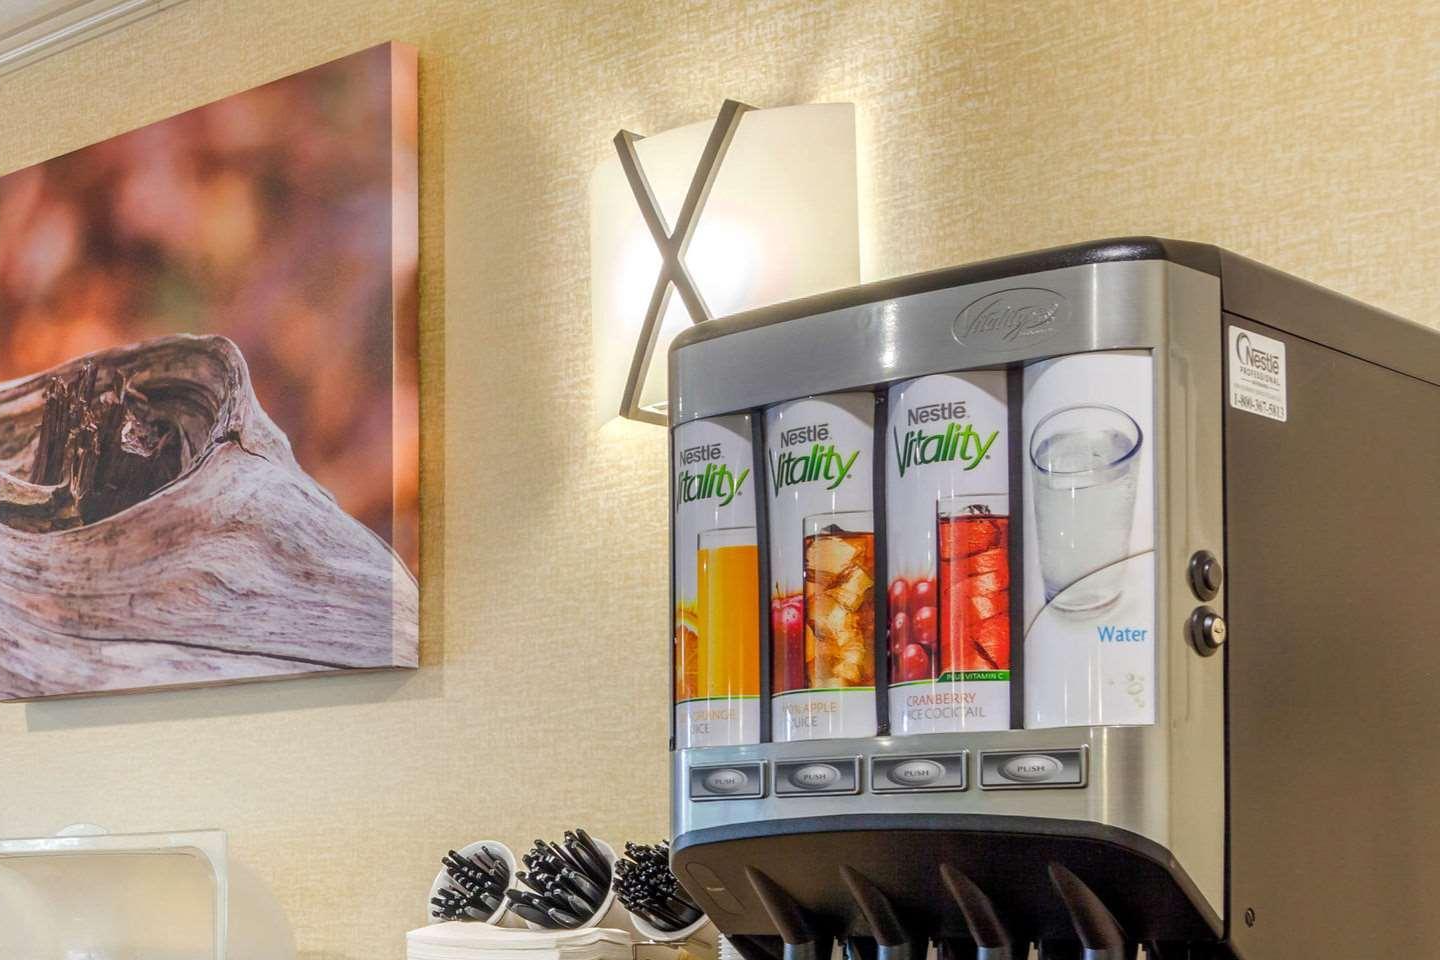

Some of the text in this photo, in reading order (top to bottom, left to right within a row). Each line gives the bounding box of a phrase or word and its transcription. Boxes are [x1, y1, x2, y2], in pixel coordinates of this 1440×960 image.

[893, 422, 999, 478] Vitality
[769, 443, 860, 498] Vitality
[1096, 625, 1148, 643] Water
[965, 672, 995, 680] VITAMIN
[998, 672, 1003, 680] C
[804, 701, 840, 714] APPLE
[907, 692, 976, 708] CRANBERRY
